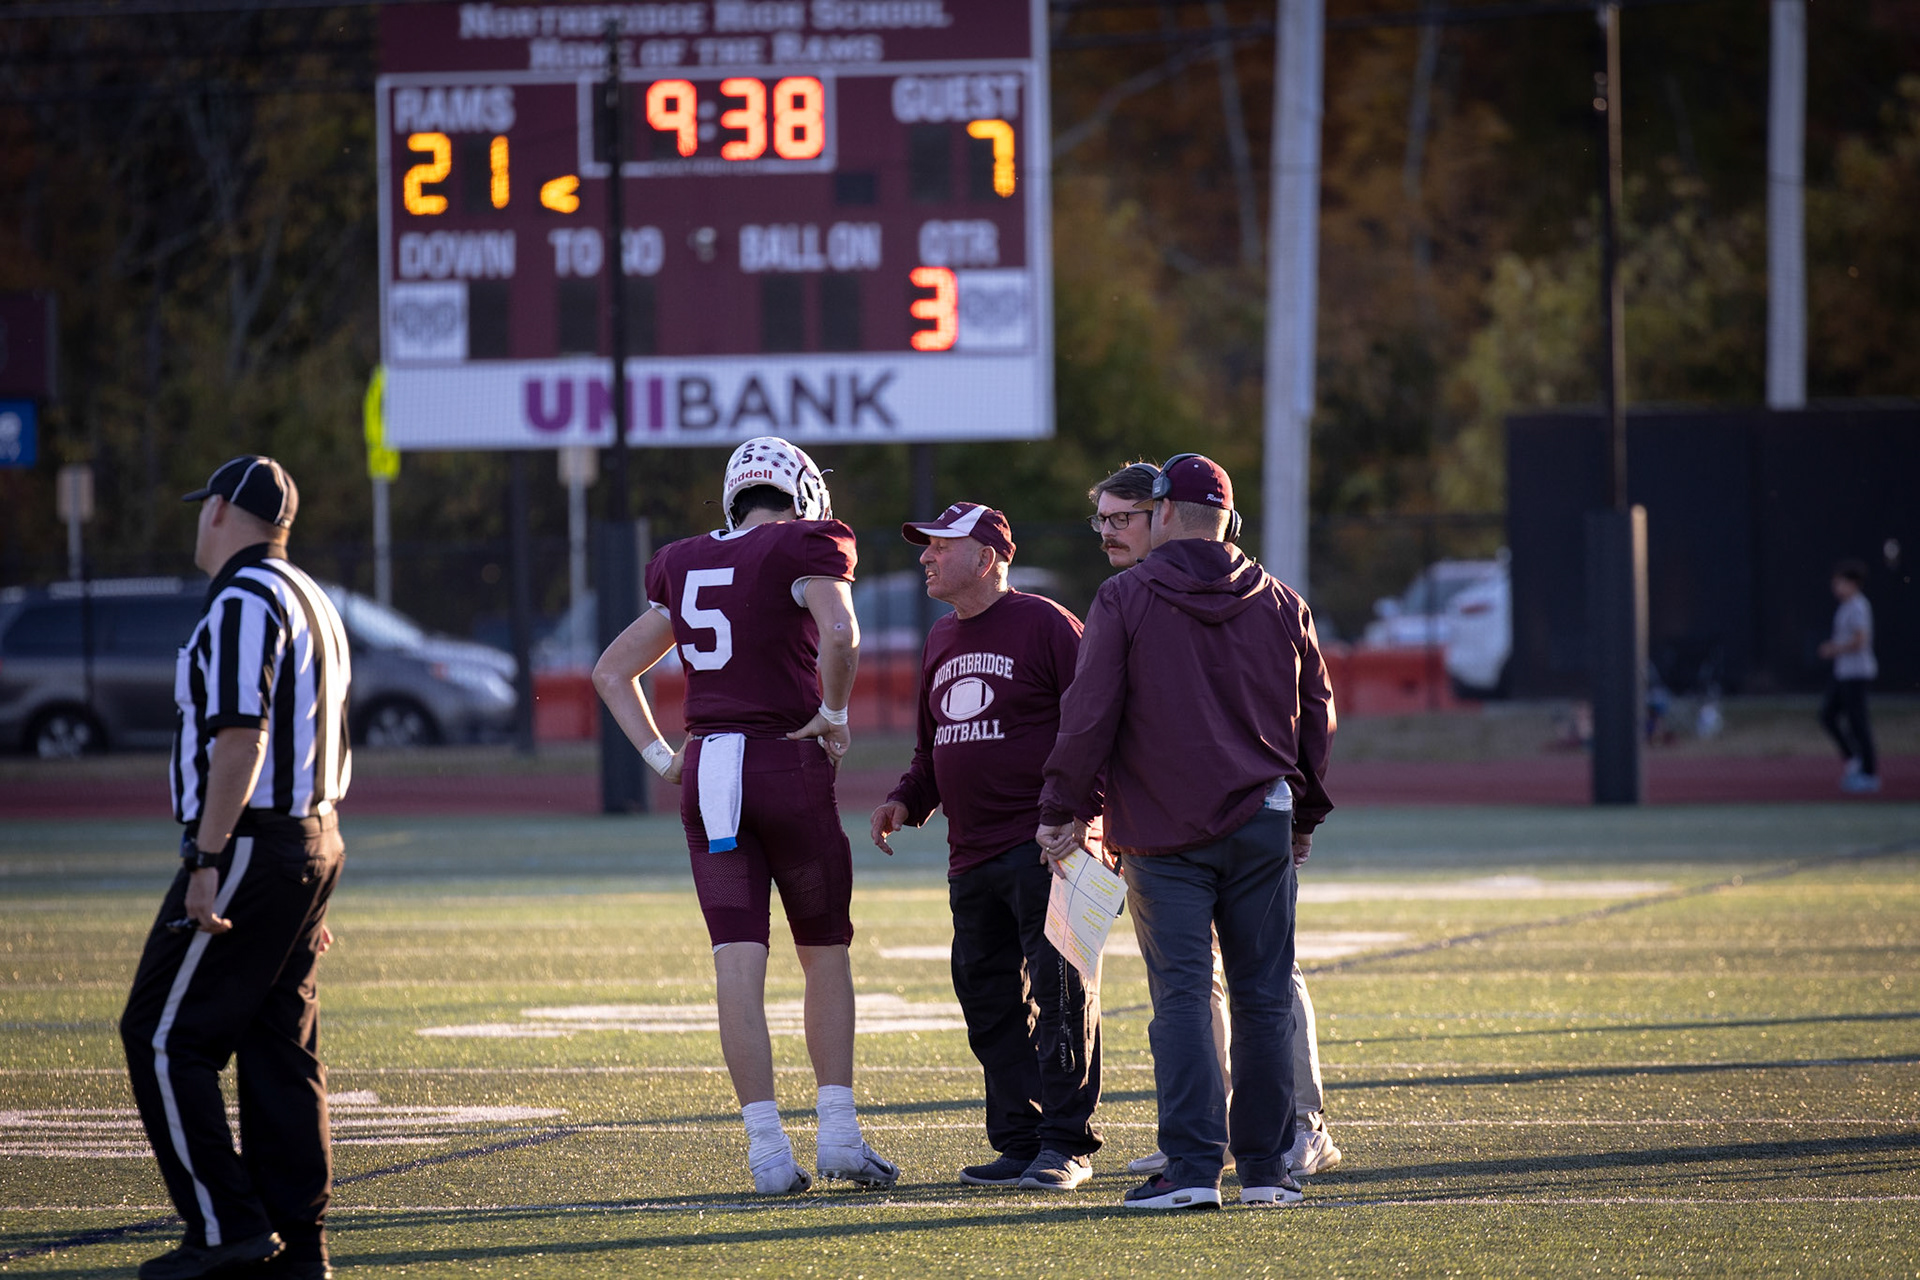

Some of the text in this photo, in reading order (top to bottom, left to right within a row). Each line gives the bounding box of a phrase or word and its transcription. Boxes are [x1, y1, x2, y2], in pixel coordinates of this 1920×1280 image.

[394, 87, 515, 133] RAMS
[646, 77, 826, 162] 9:38
[891, 74, 1022, 123] GUEST
[403, 132, 510, 215] 21
[965, 119, 1016, 198] 7
[398, 230, 517, 279] DOWN
[548, 227, 604, 277] TO
[739, 221, 882, 273] BALL ON
[918, 219, 999, 267] QTR
[908, 266, 959, 352] 3
[523, 370, 898, 434] UNIBANK
[727, 470, 773, 492] Riddell
[741, 447, 755, 465] 5
[680, 567, 735, 672] 5
[931, 652, 1015, 692] NORTHBRIDGE
